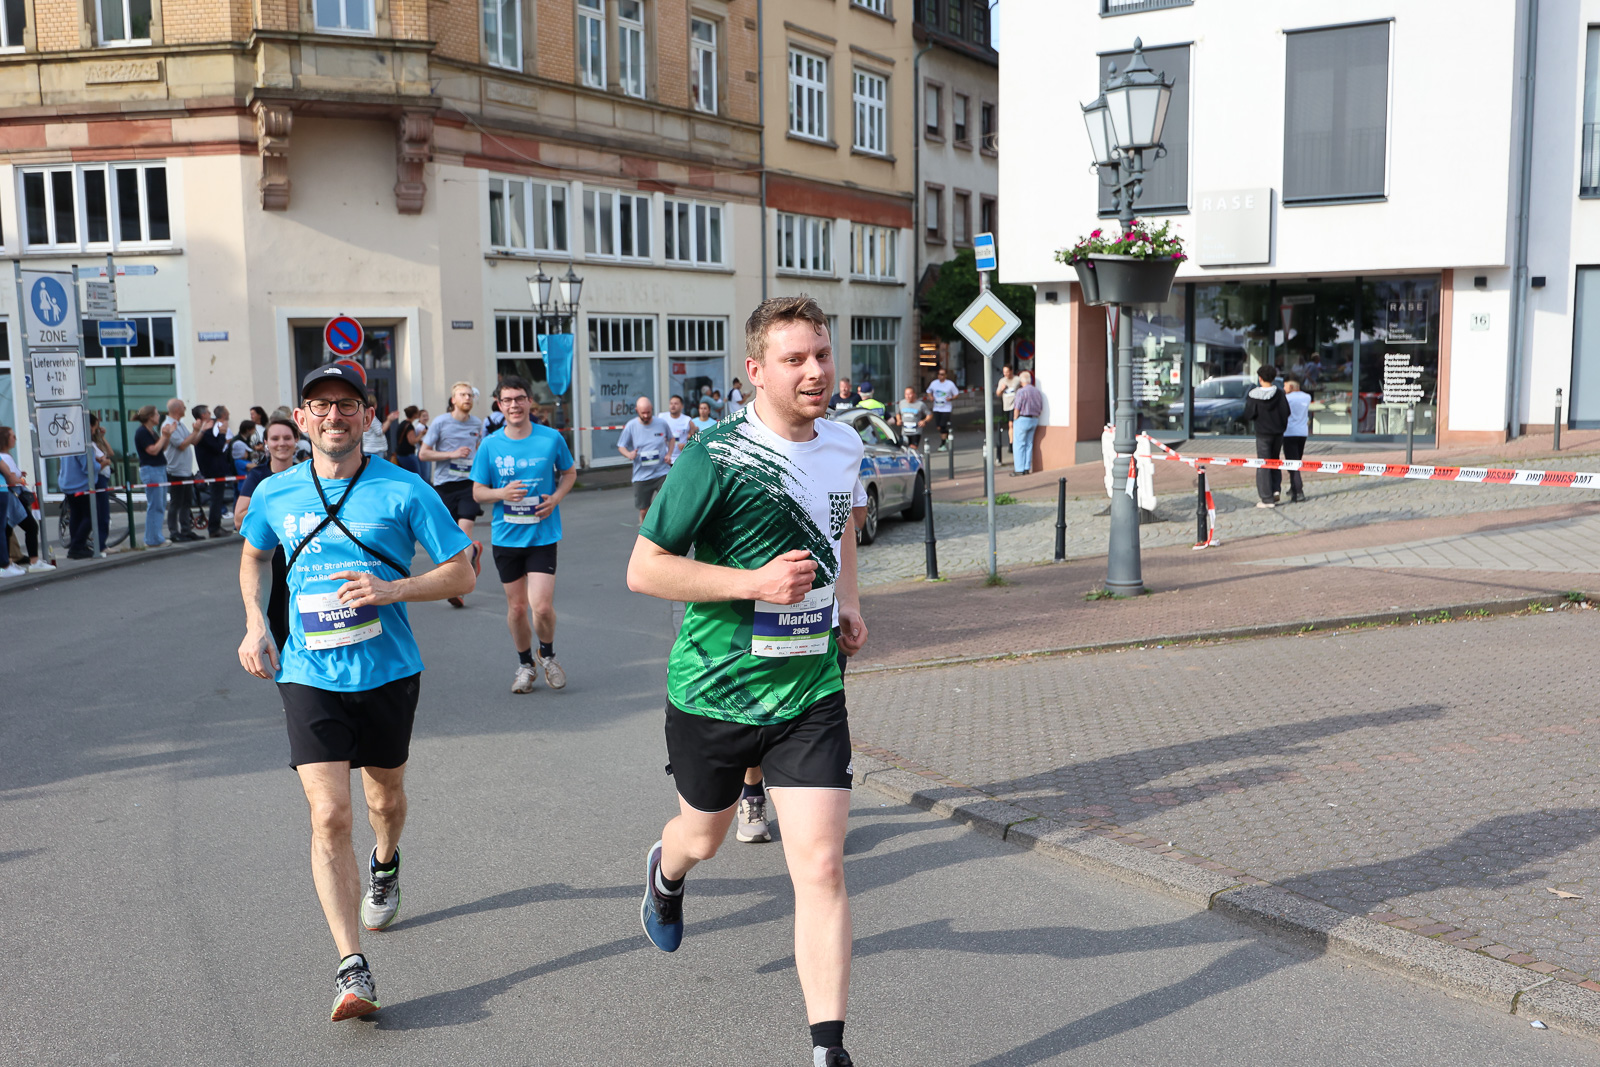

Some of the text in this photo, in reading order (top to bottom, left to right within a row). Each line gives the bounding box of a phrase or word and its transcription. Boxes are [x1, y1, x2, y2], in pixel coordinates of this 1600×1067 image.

[1202, 194, 1255, 211] RASE
[1474, 316, 1487, 325] 16
[39, 330, 68, 343] ZONE
[33, 357, 76, 369] Lieferverkehr
[51, 386, 65, 396] frei
[600, 379, 629, 397] mehr
[610, 399, 639, 416] Lebe
[55, 438, 70, 448] frei
[498, 468, 515, 477] UKS
[1347, 464, 1394, 473] ORDNUNGSAMT
[1399, 467, 1454, 477] ORDNUNGSAMT
[1458, 469, 1520, 481] ORDNUNGSAMT
[1525, 472, 1594, 485] ORDNUNGSAMT
[312, 564, 323, 572] für
[318, 607, 358, 623] Patrick
[778, 612, 823, 626] Markus
[333, 621, 346, 629] 905
[792, 627, 810, 635] 2965
